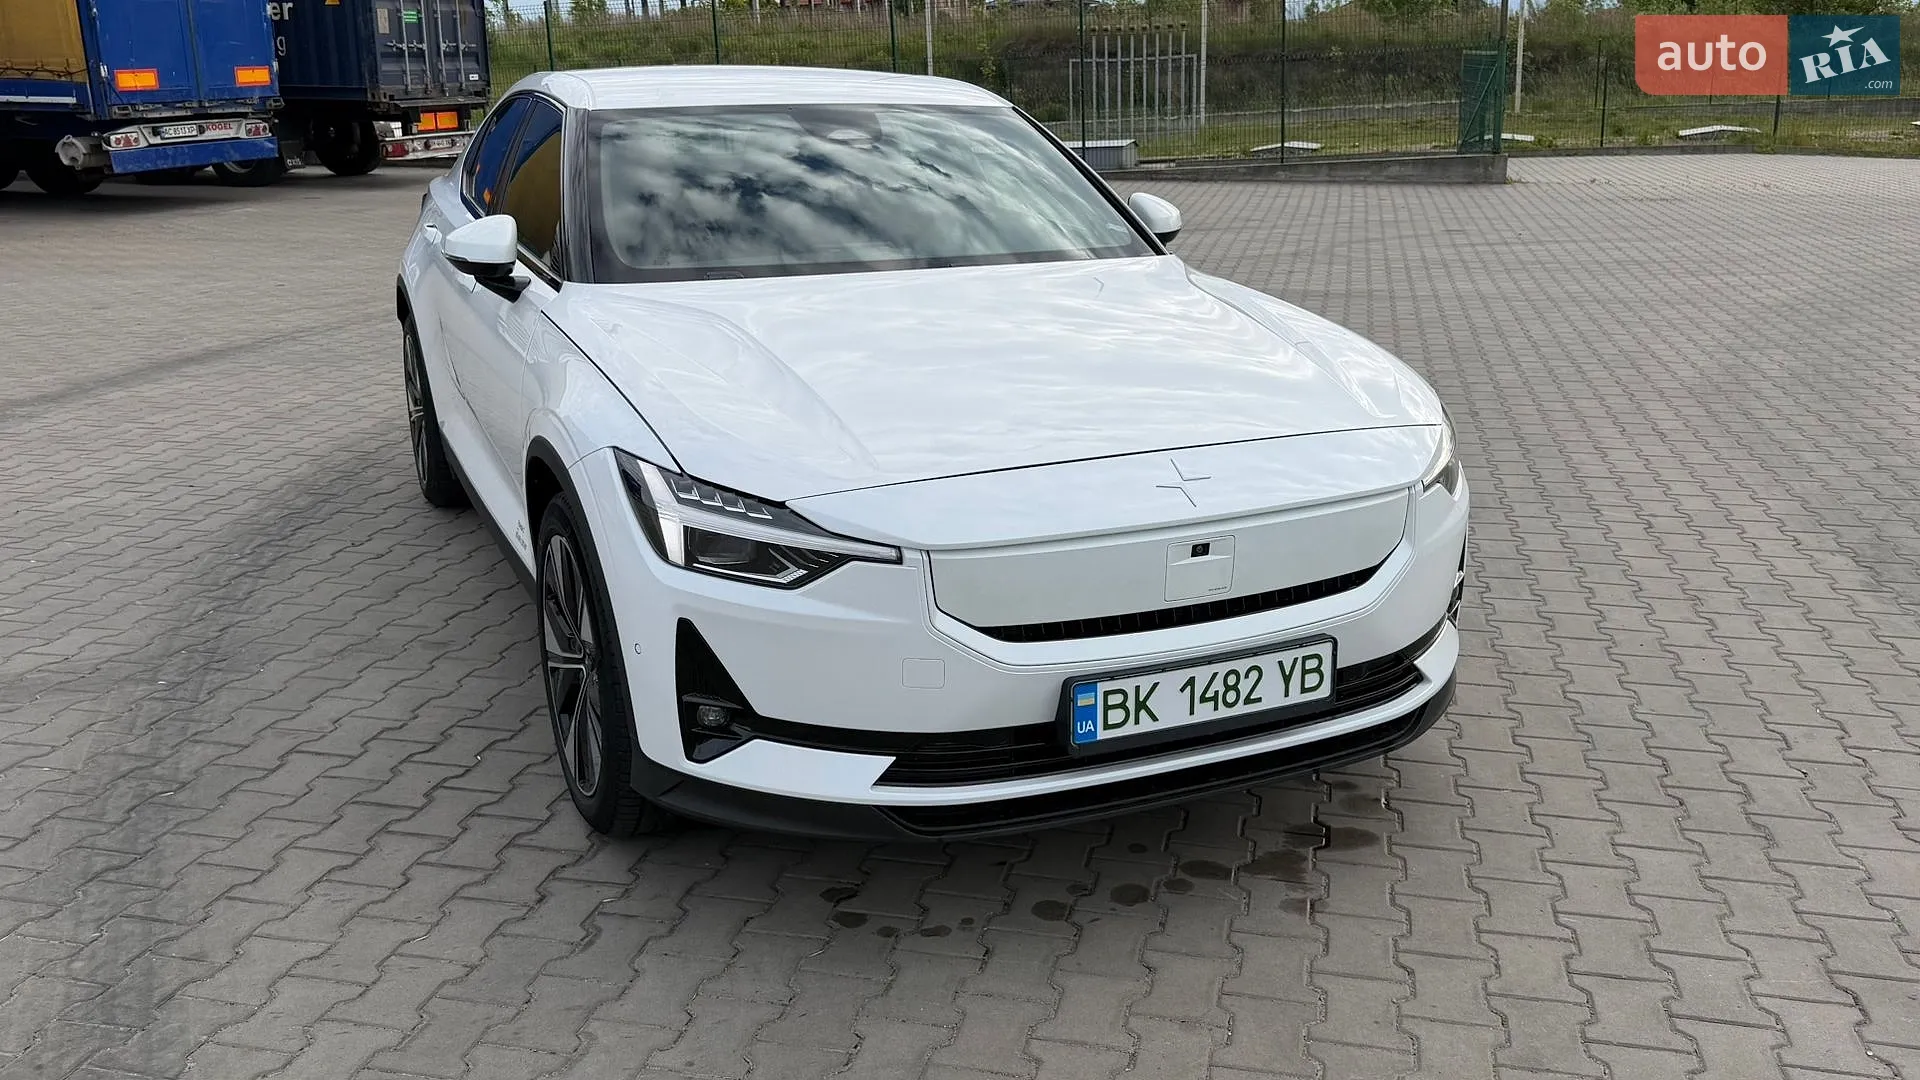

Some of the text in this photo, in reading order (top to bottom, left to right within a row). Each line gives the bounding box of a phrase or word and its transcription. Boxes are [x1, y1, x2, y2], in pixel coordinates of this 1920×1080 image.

[1102, 652, 1325, 731] BK 1482 YB
[1077, 720, 1095, 734] UA
